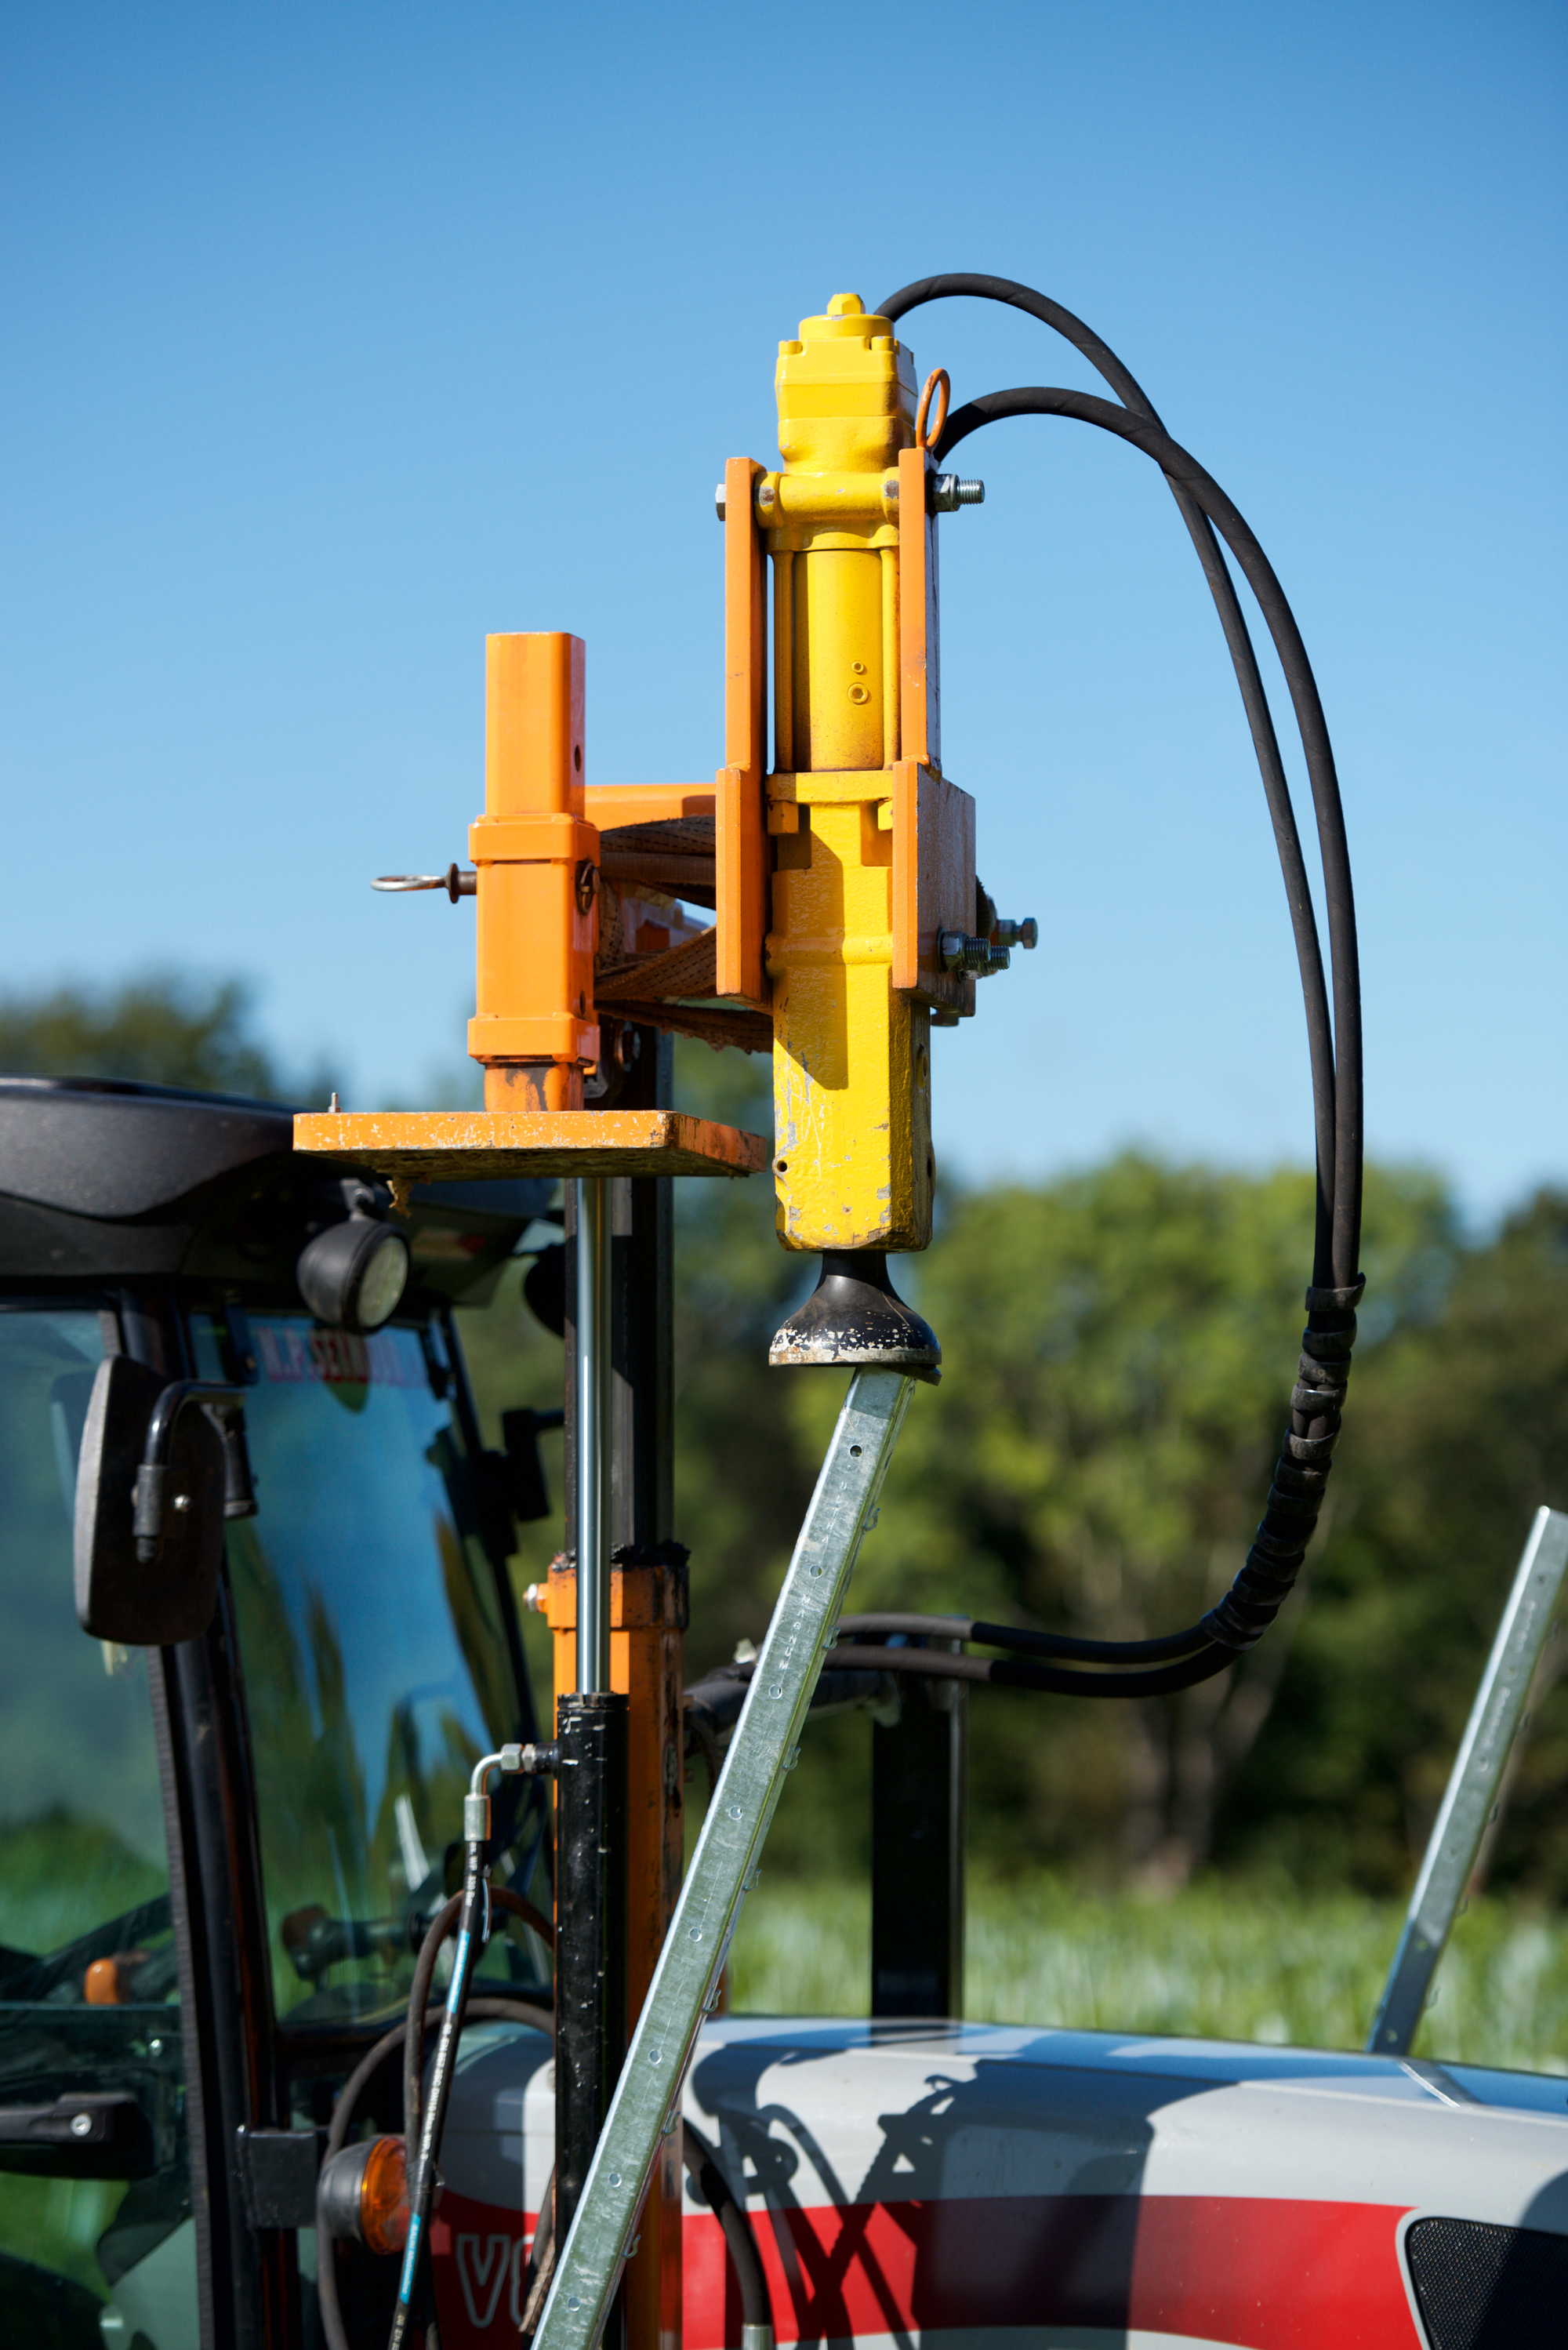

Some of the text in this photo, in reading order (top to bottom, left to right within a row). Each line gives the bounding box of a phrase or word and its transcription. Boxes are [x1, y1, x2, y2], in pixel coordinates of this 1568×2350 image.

[779, 1595, 811, 1670] MAGNUM
[465, 1891, 475, 1907] Bar
[439, 2036, 450, 2051] EN
[427, 2087, 440, 2112] DN10
[401, 2250, 415, 2294] Motionline
[393, 2328, 403, 2342] EN
